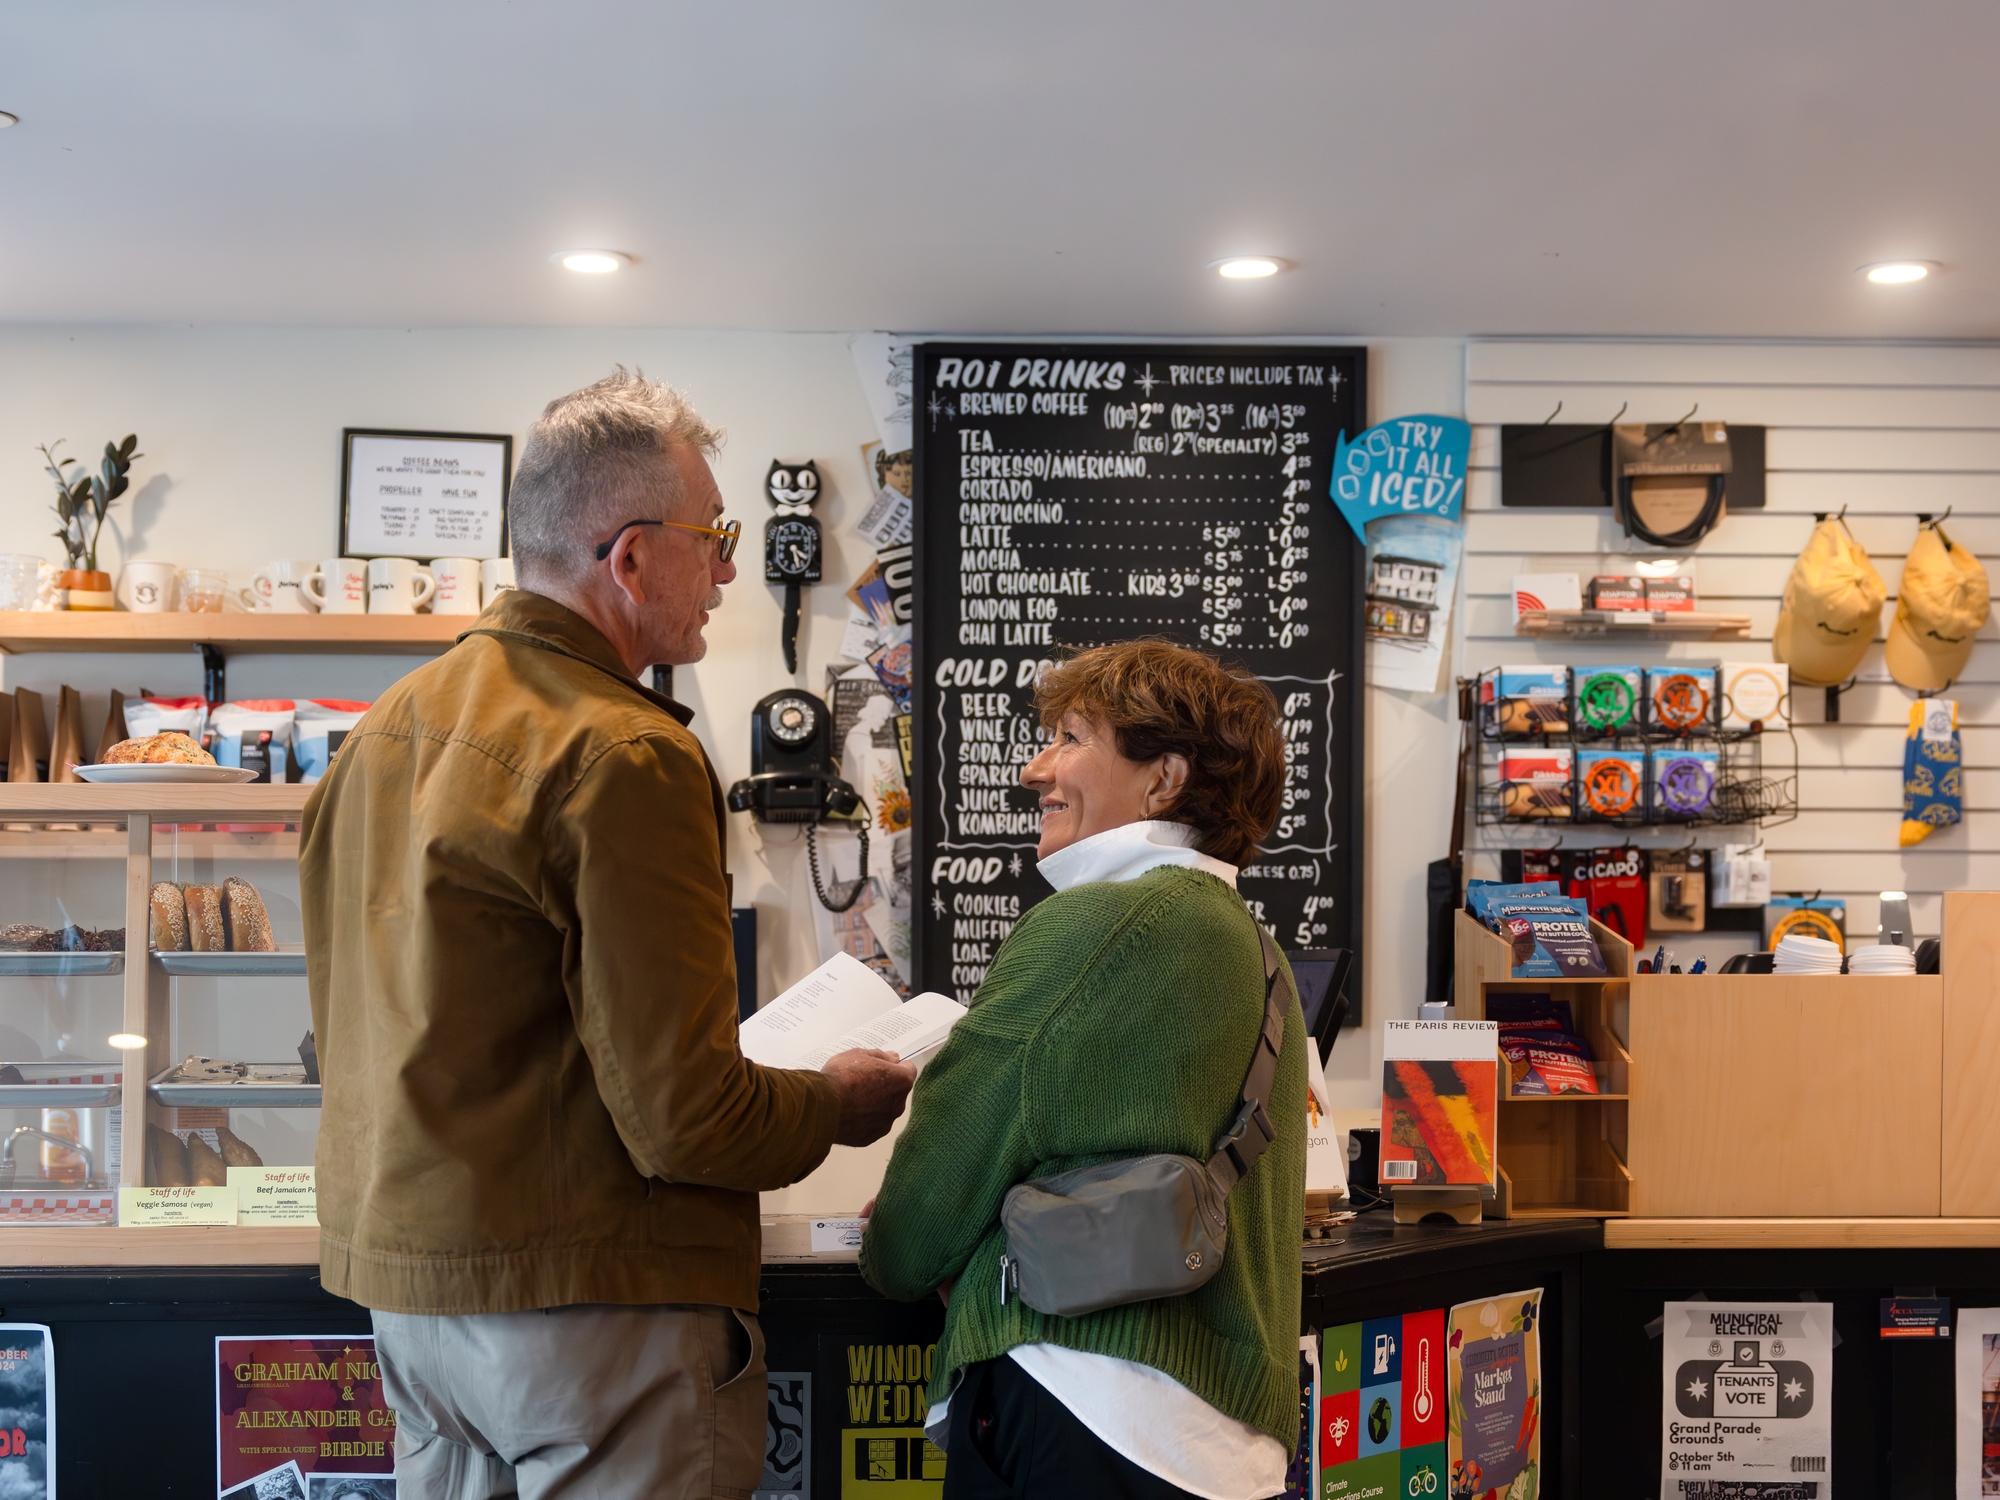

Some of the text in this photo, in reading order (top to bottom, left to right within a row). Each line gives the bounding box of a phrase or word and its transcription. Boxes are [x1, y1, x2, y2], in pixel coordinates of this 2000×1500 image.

[1009, 358, 1126, 391] DRINKS
[1169, 365, 1324, 386] PRICES INCLUDE TAX
[960, 393, 1088, 416] BREWED COFFEE
[958, 429, 994, 453] TEA
[1397, 421, 1443, 450] TRY
[960, 453, 1147, 481] ESPRESSO/AMERICANO
[1387, 446, 1454, 479] IT ALL
[959, 479, 1032, 502] CORTADO
[1369, 471, 1463, 515] ICED!
[959, 502, 1063, 526] CAPPUCCINO
[960, 525, 1012, 549] LATTE
[1268, 527, 1278, 542] L
[960, 549, 1021, 572] MOCHA
[1268, 552, 1278, 566] L
[960, 572, 993, 596] HOT
[997, 571, 1092, 596] CHOCOLATE
[1127, 573, 1166, 597] KIDS
[1268, 576, 1277, 589] L
[960, 598, 1020, 622] LONDON
[1027, 597, 1058, 621] FOG
[1269, 600, 1279, 613] L
[959, 623, 996, 646] CHAI
[1003, 622, 1053, 646] LATTE
[1269, 625, 1278, 638] L
[935, 657, 1008, 688] COLD
[960, 693, 1011, 717] BEER
[1591, 690, 1624, 711] XL
[1667, 690, 1698, 712] XL
[959, 719, 1006, 742] WINE
[1596, 775, 1628, 798] XL
[1671, 774, 1703, 797] XL
[955, 788, 1011, 812] JUICE
[931, 856, 1003, 885] FOOD
[1594, 862, 1638, 878] CAPO
[953, 892, 1020, 917] COOKIES
[952, 943, 992, 963] LOAF
[1415, 1022, 1448, 1030] PARIS
[265, 1173, 310, 1183] Staff of life
[150, 1188, 196, 1198] Staff of life
[256, 1186, 274, 1195] Beef
[136, 1201, 160, 1209] Veggie
[190, 1201, 213, 1209] (vegan)
[1710, 1313, 1783, 1325] MUNICIPAL
[1715, 1323, 1778, 1335] ELECTION
[234, 1362, 338, 1381] GRAHAM
[1475, 1366, 1513, 1390] Market
[1717, 1376, 1775, 1387] TENANTS
[342, 1386, 355, 1401] &
[1475, 1384, 1506, 1408] Stand
[1725, 1392, 1766, 1404] VOTE
[236, 1410, 362, 1429] ALEXANDER
[1669, 1422, 1762, 1434] Grand Parade
[239, 1441, 385, 1457] WITH SPECIAL GUEST BIRDIE
[1669, 1433, 1724, 1444] Grounds
[1669, 1452, 1735, 1463] October 5th
[1669, 1461, 1711, 1471] @ 11 am
[1325, 1479, 1348, 1494] Climate
[1361, 1486, 1384, 1499] Course
[1678, 1480, 1706, 1493] Every
